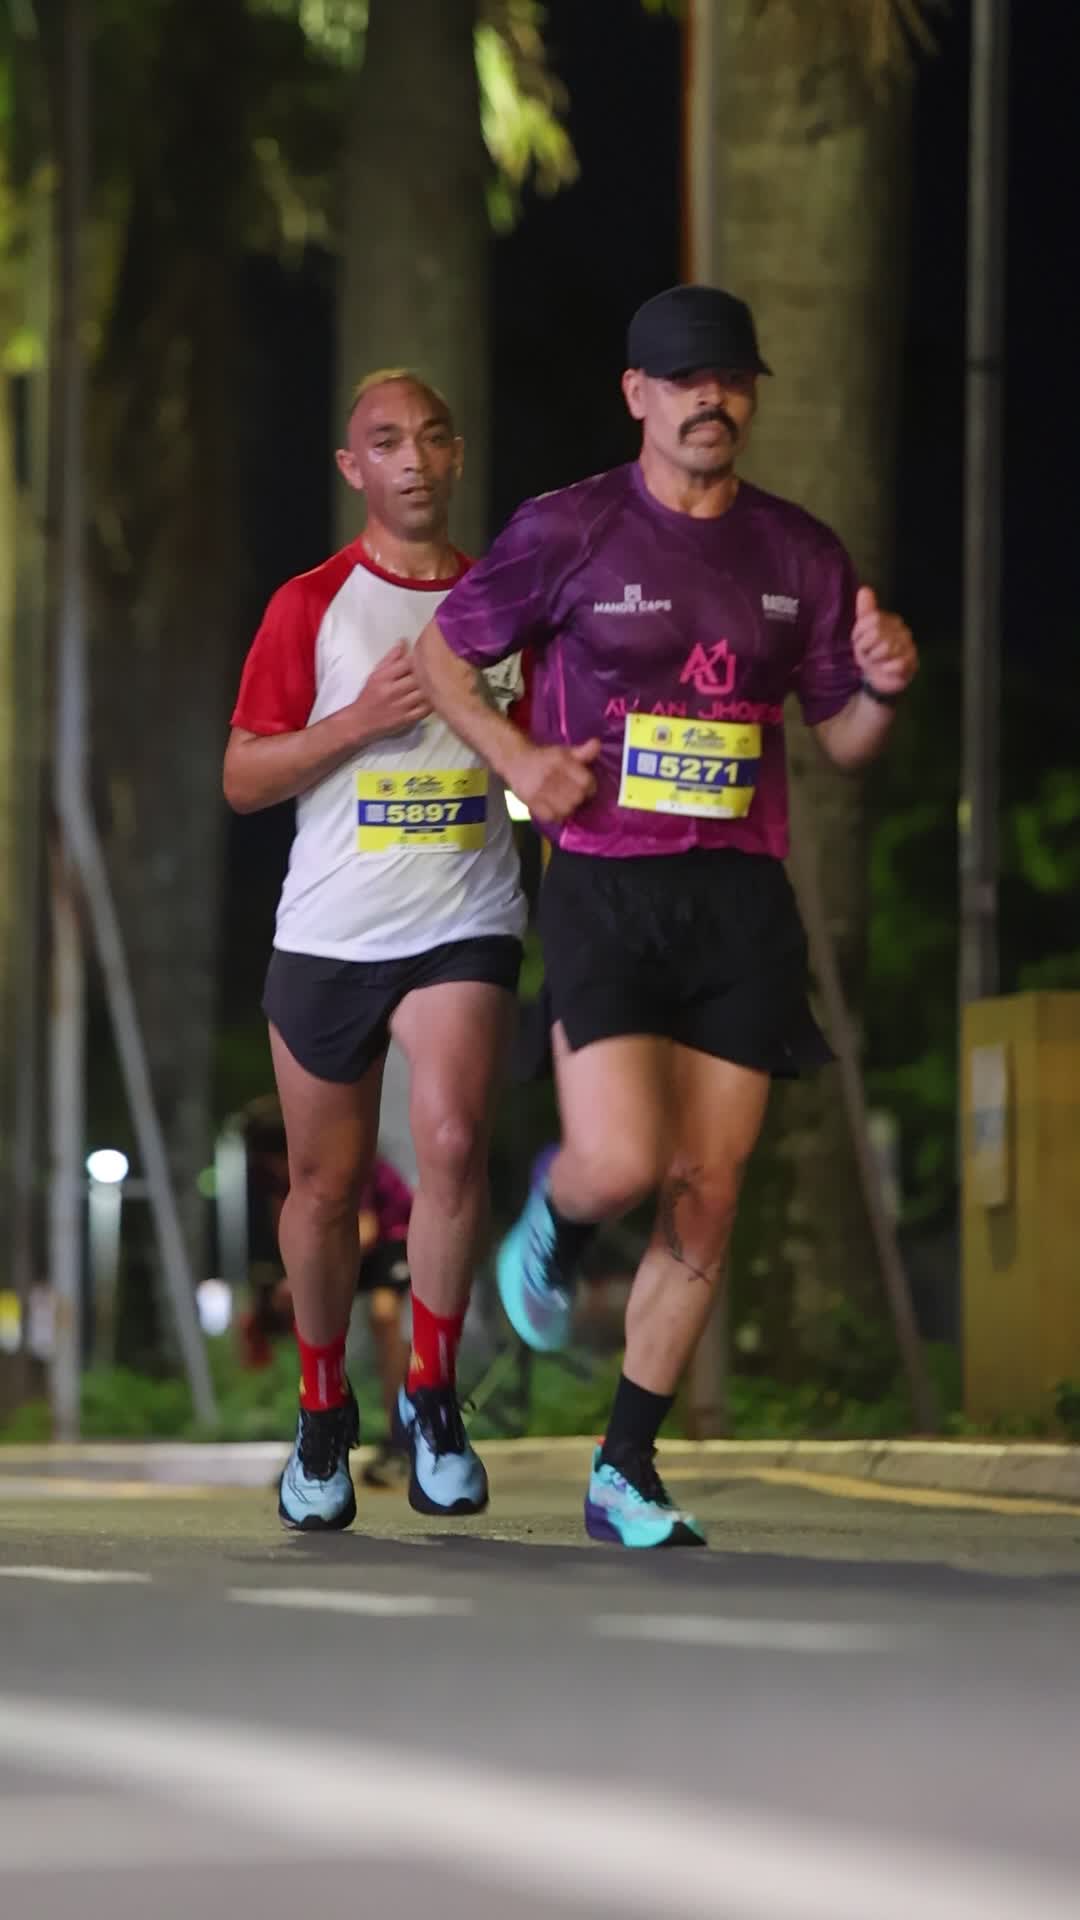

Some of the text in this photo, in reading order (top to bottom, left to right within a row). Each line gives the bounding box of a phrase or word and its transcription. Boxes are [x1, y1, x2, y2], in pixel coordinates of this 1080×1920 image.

[638, 599, 673, 612] CAPS
[658, 755, 739, 784] 5271
[386, 802, 463, 824] 5897
